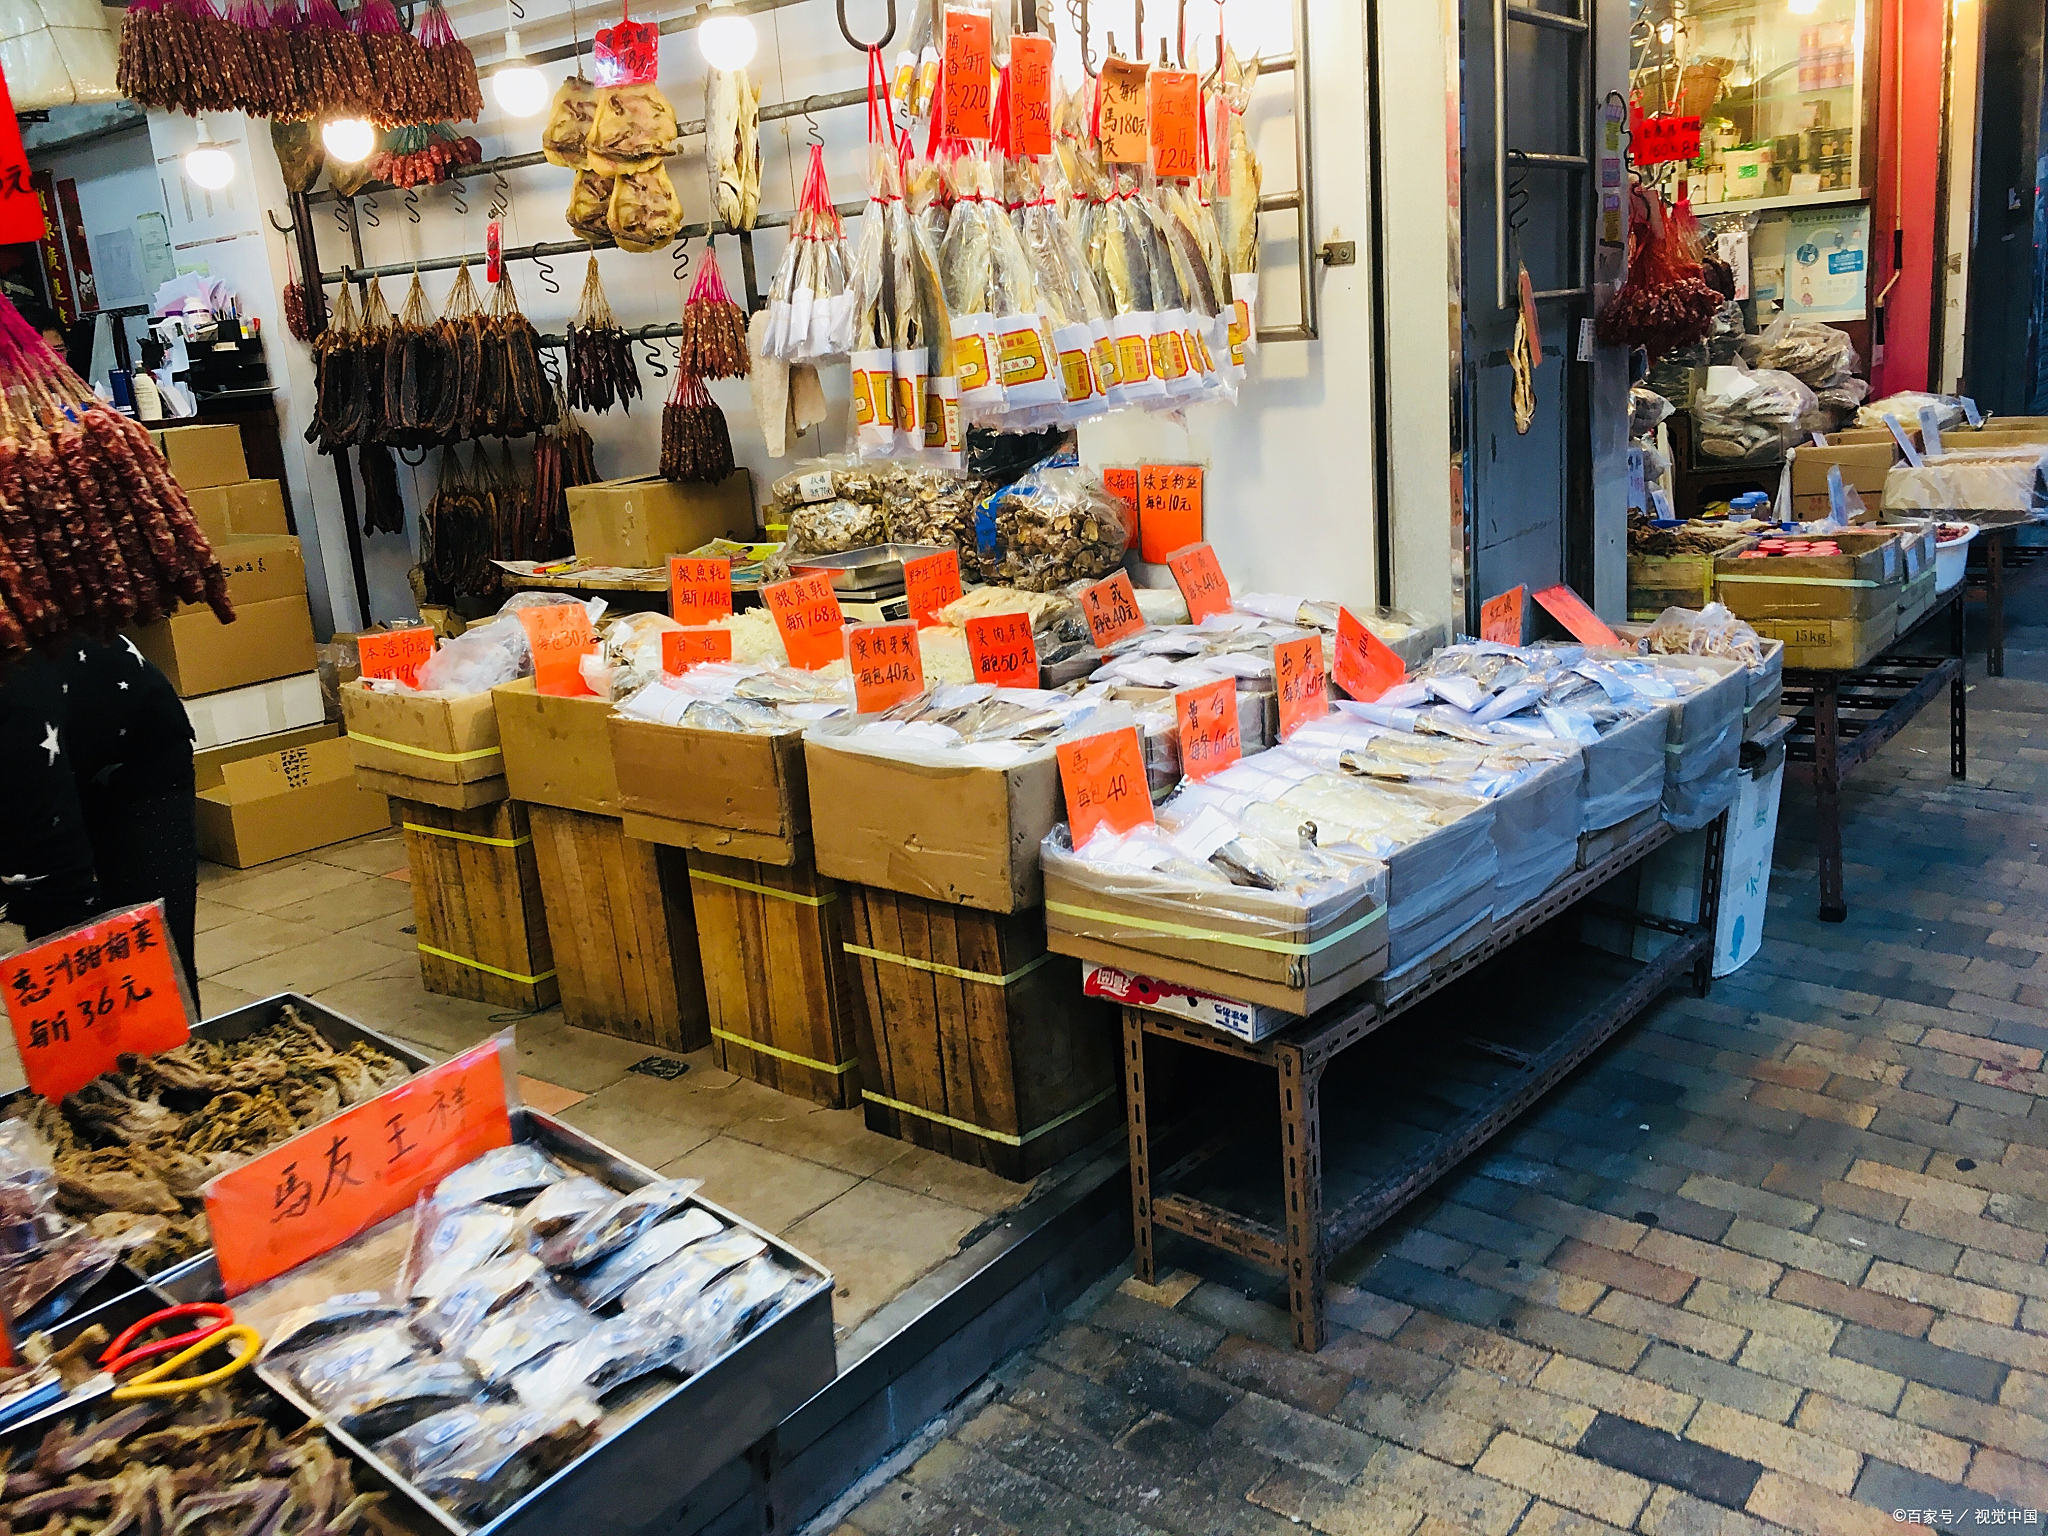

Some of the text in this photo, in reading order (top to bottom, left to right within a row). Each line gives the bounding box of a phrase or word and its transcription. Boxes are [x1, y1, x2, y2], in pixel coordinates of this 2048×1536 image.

[1145, 494, 1192, 511] 每包10元
[1092, 604, 1138, 635] 每包40元
[1795, 629, 1827, 645] 15kg
[980, 647, 1034, 673] 每包50元
[860, 662, 916, 687] 每包40元
[1077, 773, 1145, 808] 每包40元
